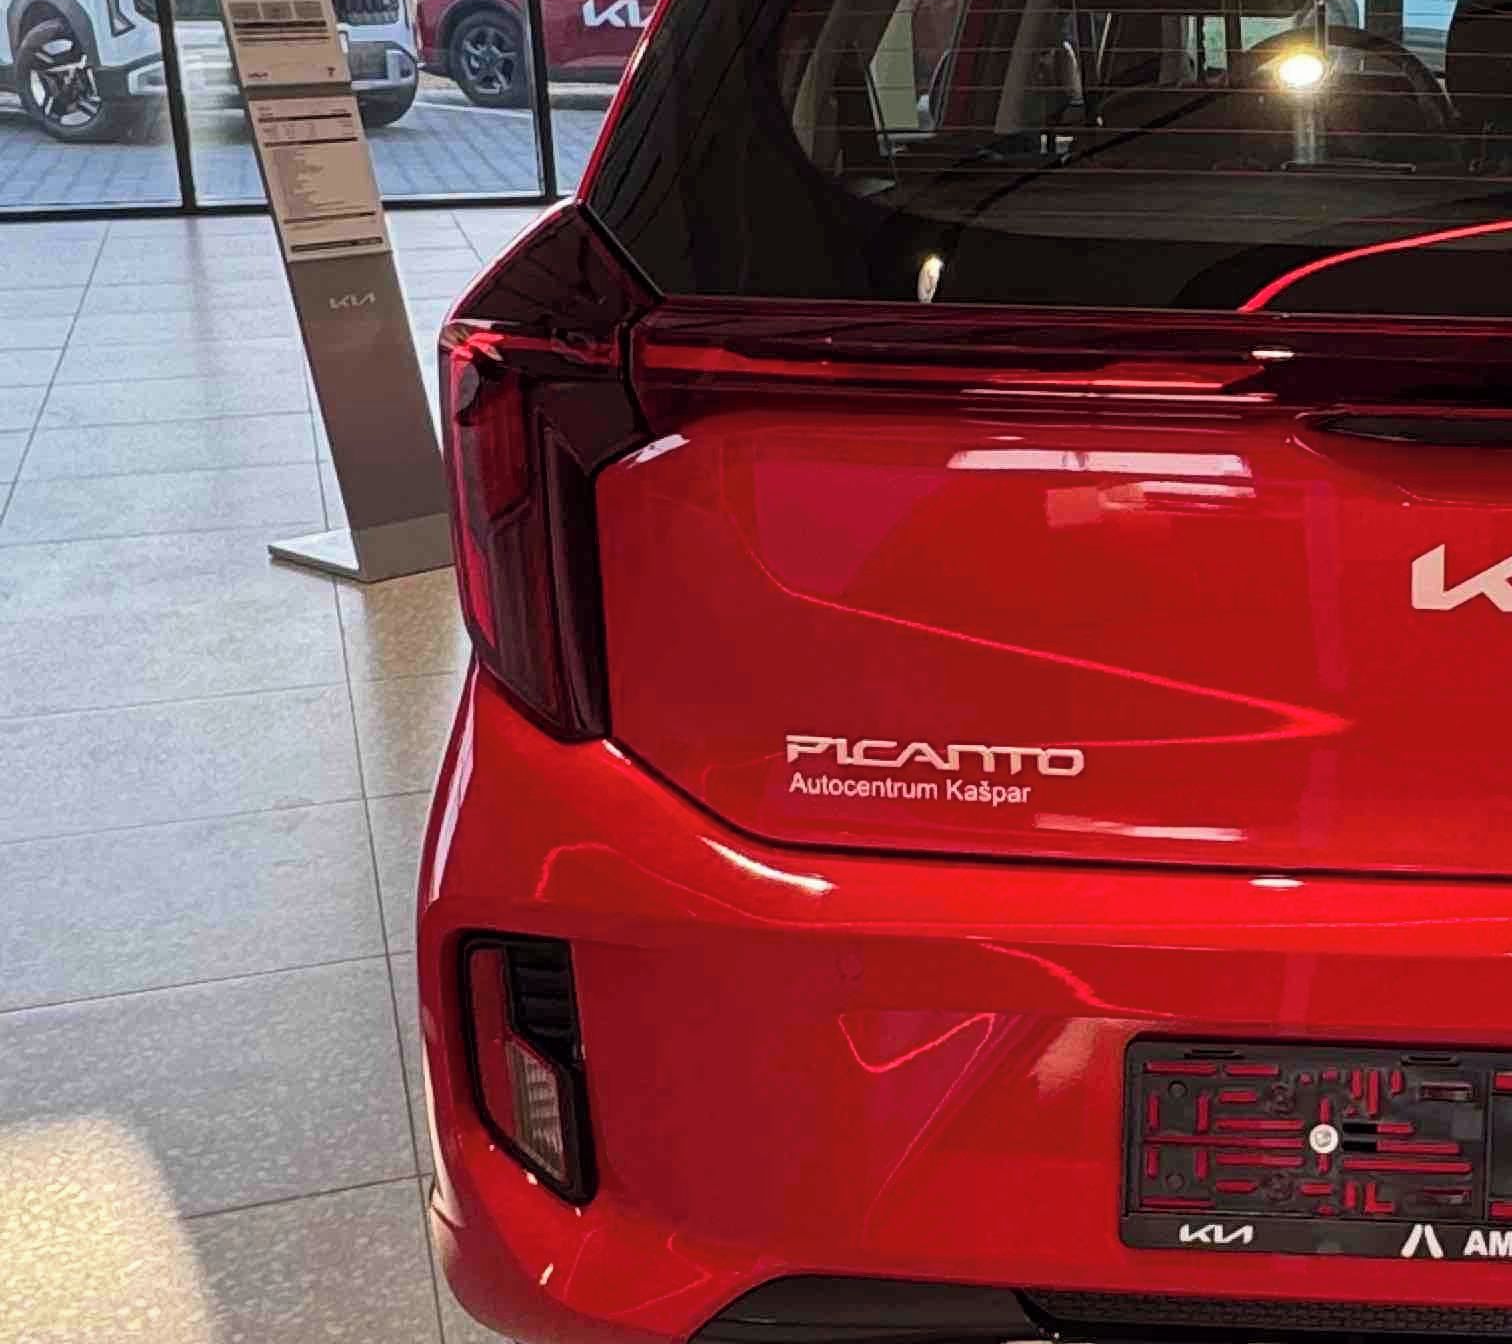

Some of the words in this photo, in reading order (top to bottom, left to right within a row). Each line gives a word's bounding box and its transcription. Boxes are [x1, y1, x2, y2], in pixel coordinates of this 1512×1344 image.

[329, 292, 376, 308] KIA
[786, 735, 1084, 776] PICANTO
[789, 771, 938, 800] Autocentrum
[946, 778, 1032, 807] Kašpar
[1179, 1224, 1254, 1244] KIA
